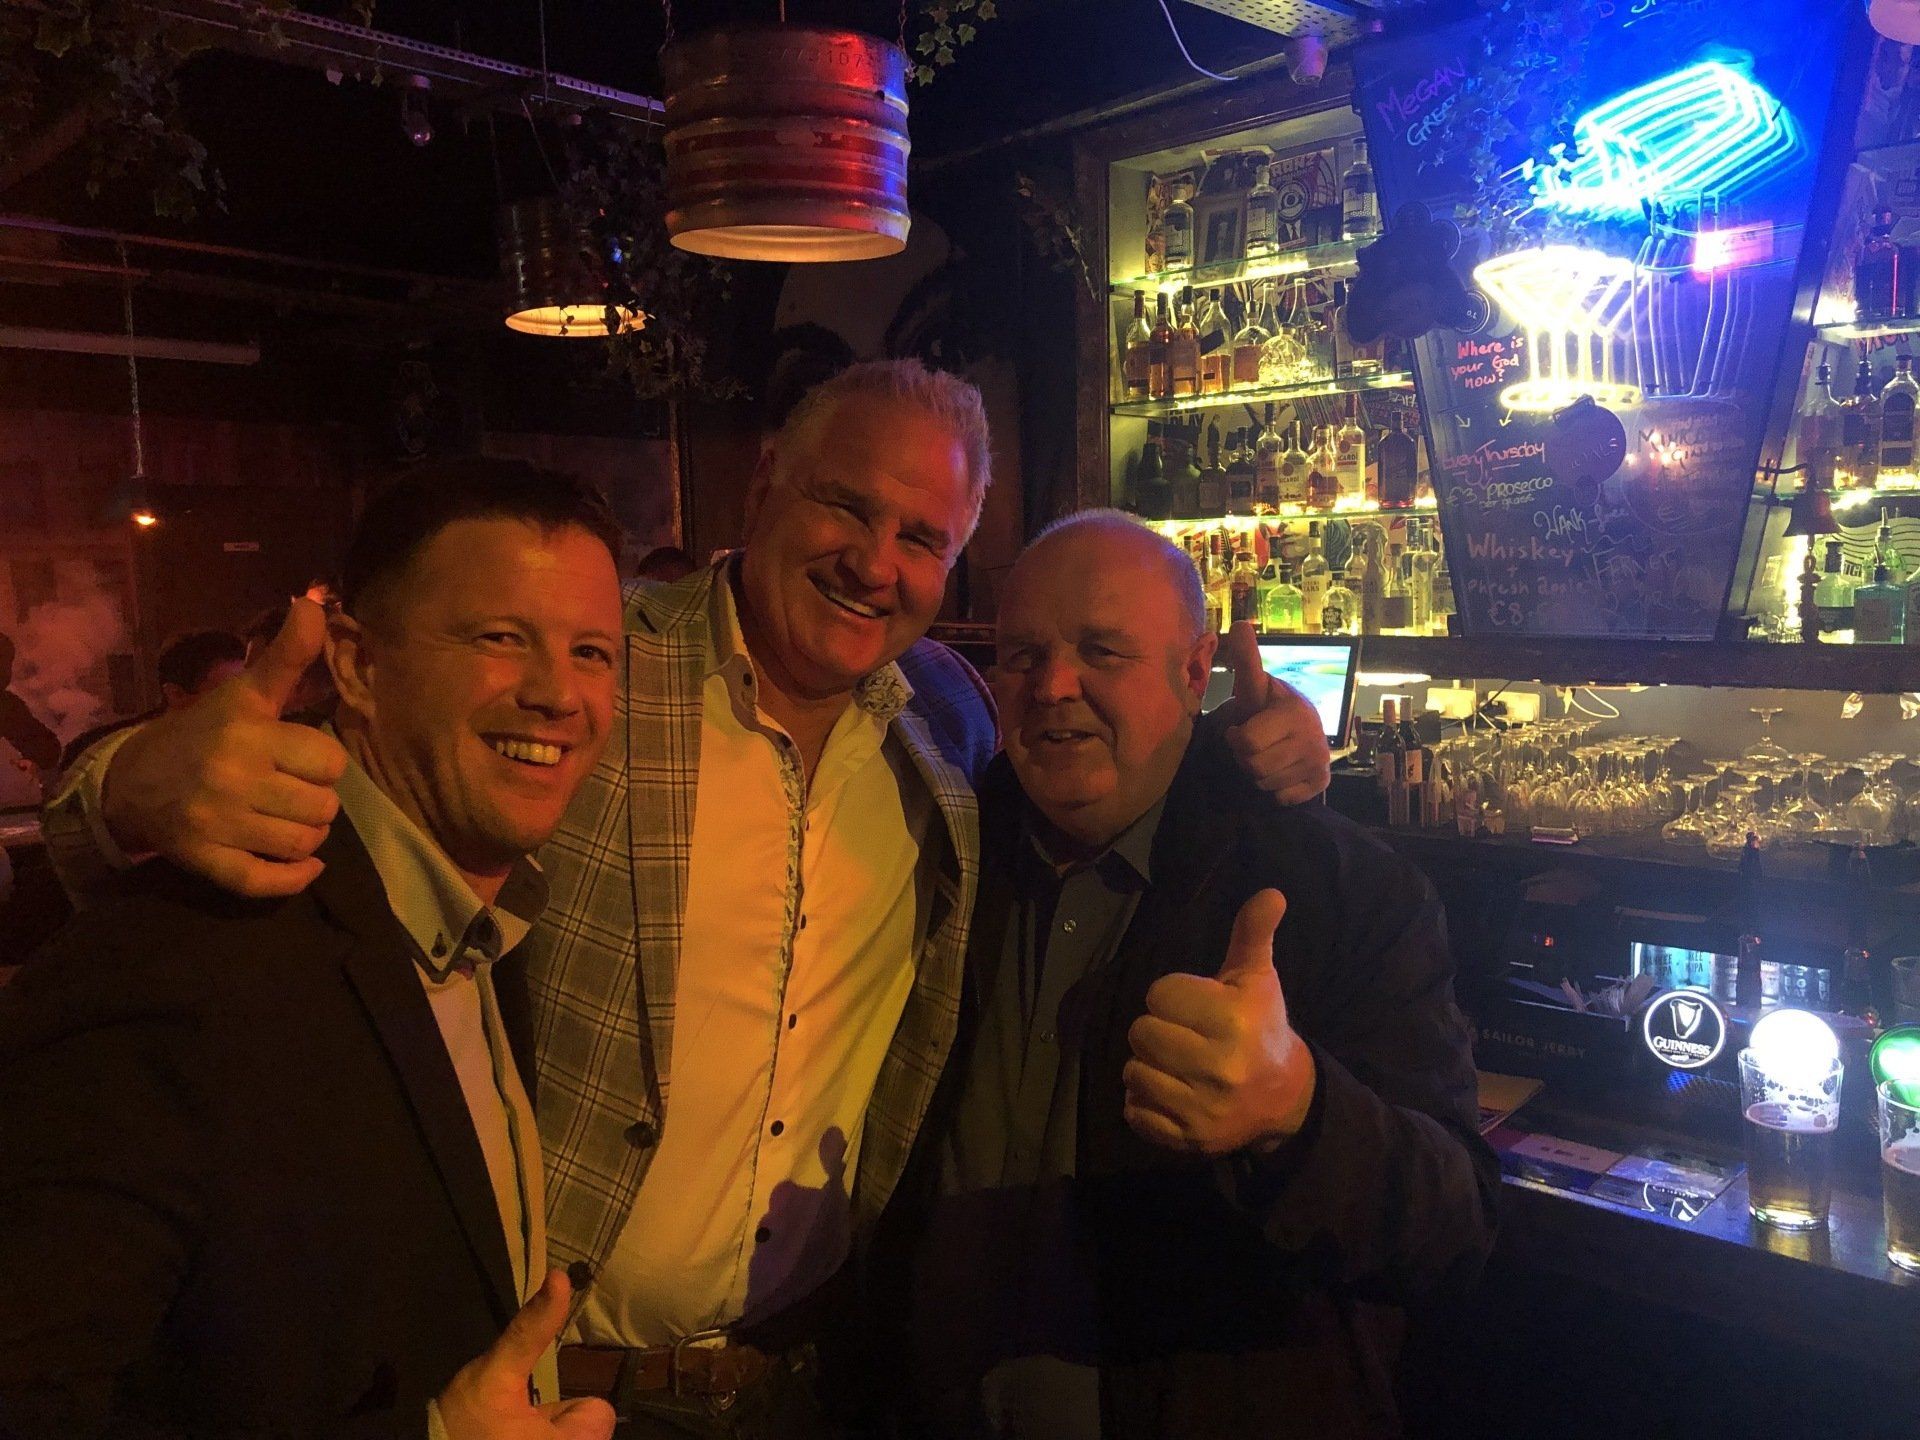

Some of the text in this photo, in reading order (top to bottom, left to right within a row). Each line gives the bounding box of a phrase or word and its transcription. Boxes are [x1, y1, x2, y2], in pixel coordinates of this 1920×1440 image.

[1457, 335, 1524, 360] Where is
[1451, 354, 1520, 381] your God
[1464, 368, 1505, 389] now?
[1476, 439, 1546, 464] Thursday
[1467, 532, 1574, 567] Whiskey
[1481, 1028, 1535, 1048] SAILOR
[1653, 1035, 1712, 1056] GUINNESS
